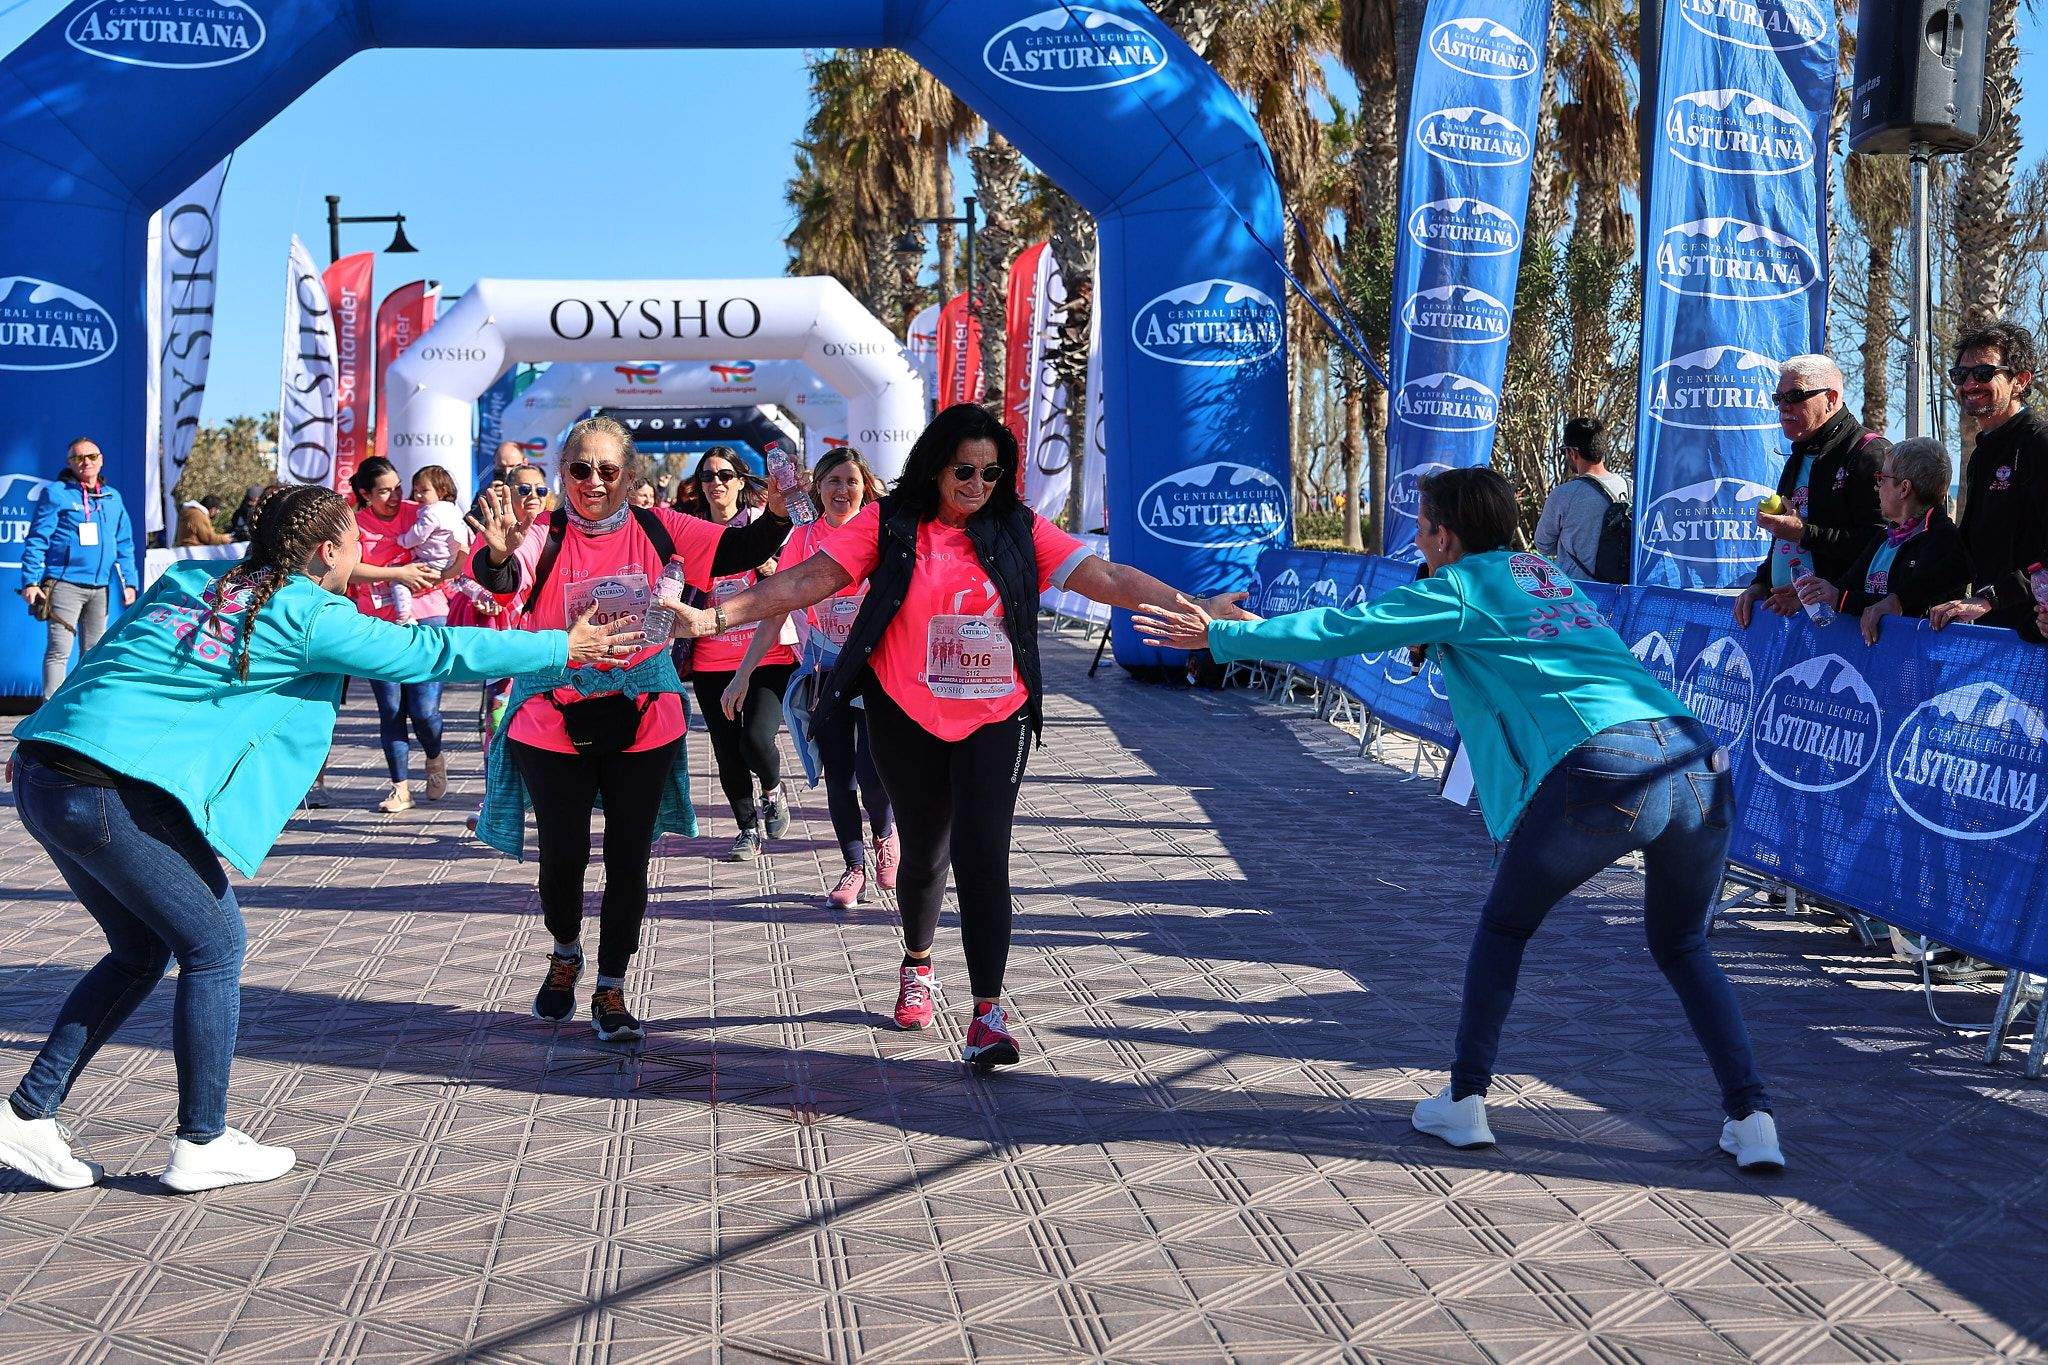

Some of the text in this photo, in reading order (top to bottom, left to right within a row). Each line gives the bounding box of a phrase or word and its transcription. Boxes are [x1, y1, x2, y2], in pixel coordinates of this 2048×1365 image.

[76, 12, 251, 49] ASTURIANA
[999, 41, 1157, 72] ASTURIANA
[1436, 31, 1530, 71] ASTURIANA
[1423, 122, 1522, 158] ASTURIANA
[1669, 110, 1805, 162] ASTURIANA
[1415, 215, 1513, 247] ASTURIANA
[1659, 240, 1803, 285] ASTURIANA
[550, 298, 761, 341] OYSHO
[1143, 313, 1277, 346] ASTURIANA
[1408, 305, 1504, 334] ASTURIANA
[338, 286, 358, 403] Santander
[421, 348, 486, 362] OYSHO
[823, 343, 885, 356] OYSHO
[955, 321, 969, 401] antander
[1400, 392, 1493, 421] ASTURIANA
[1654, 378, 1778, 410] ASTURIA
[625, 417, 733, 430] VOLVO
[860, 429, 917, 443] OYSHO
[393, 433, 453, 447] OYSHO
[1149, 495, 1283, 527] ASTURIANA
[1648, 511, 1772, 544] ASTURIA
[960, 653, 991, 667] 016
[937, 686, 965, 694] OYSHO
[1757, 693, 1865, 768] ASTURIANA
[1894, 726, 2038, 813] ASTURIANA
